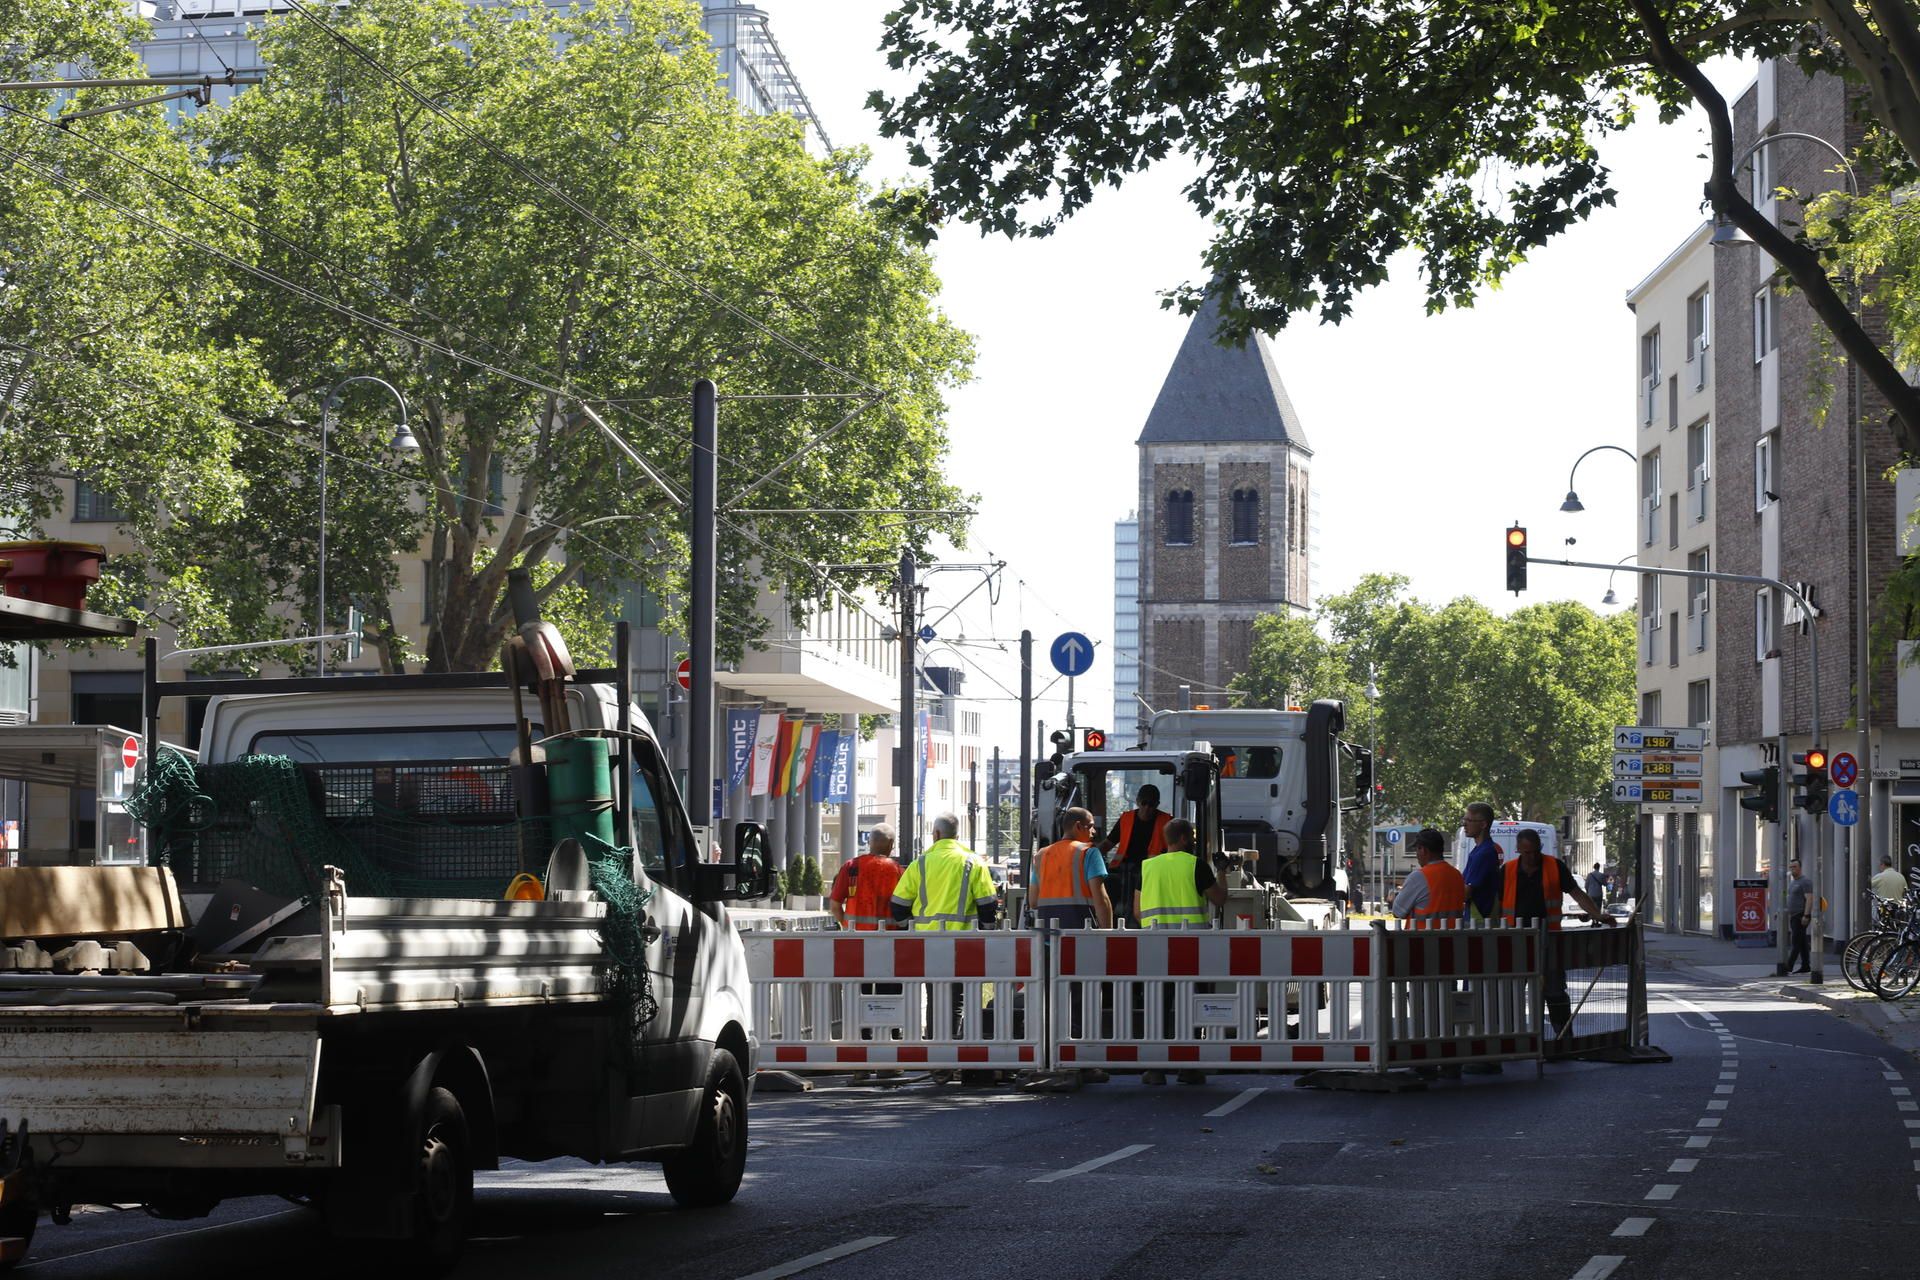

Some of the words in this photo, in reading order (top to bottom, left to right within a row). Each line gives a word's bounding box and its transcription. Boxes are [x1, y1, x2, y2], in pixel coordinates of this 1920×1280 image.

[1645, 738, 1671, 747] 1987
[1644, 764, 1671, 773] 1388
[1651, 791, 1671, 800] 602
